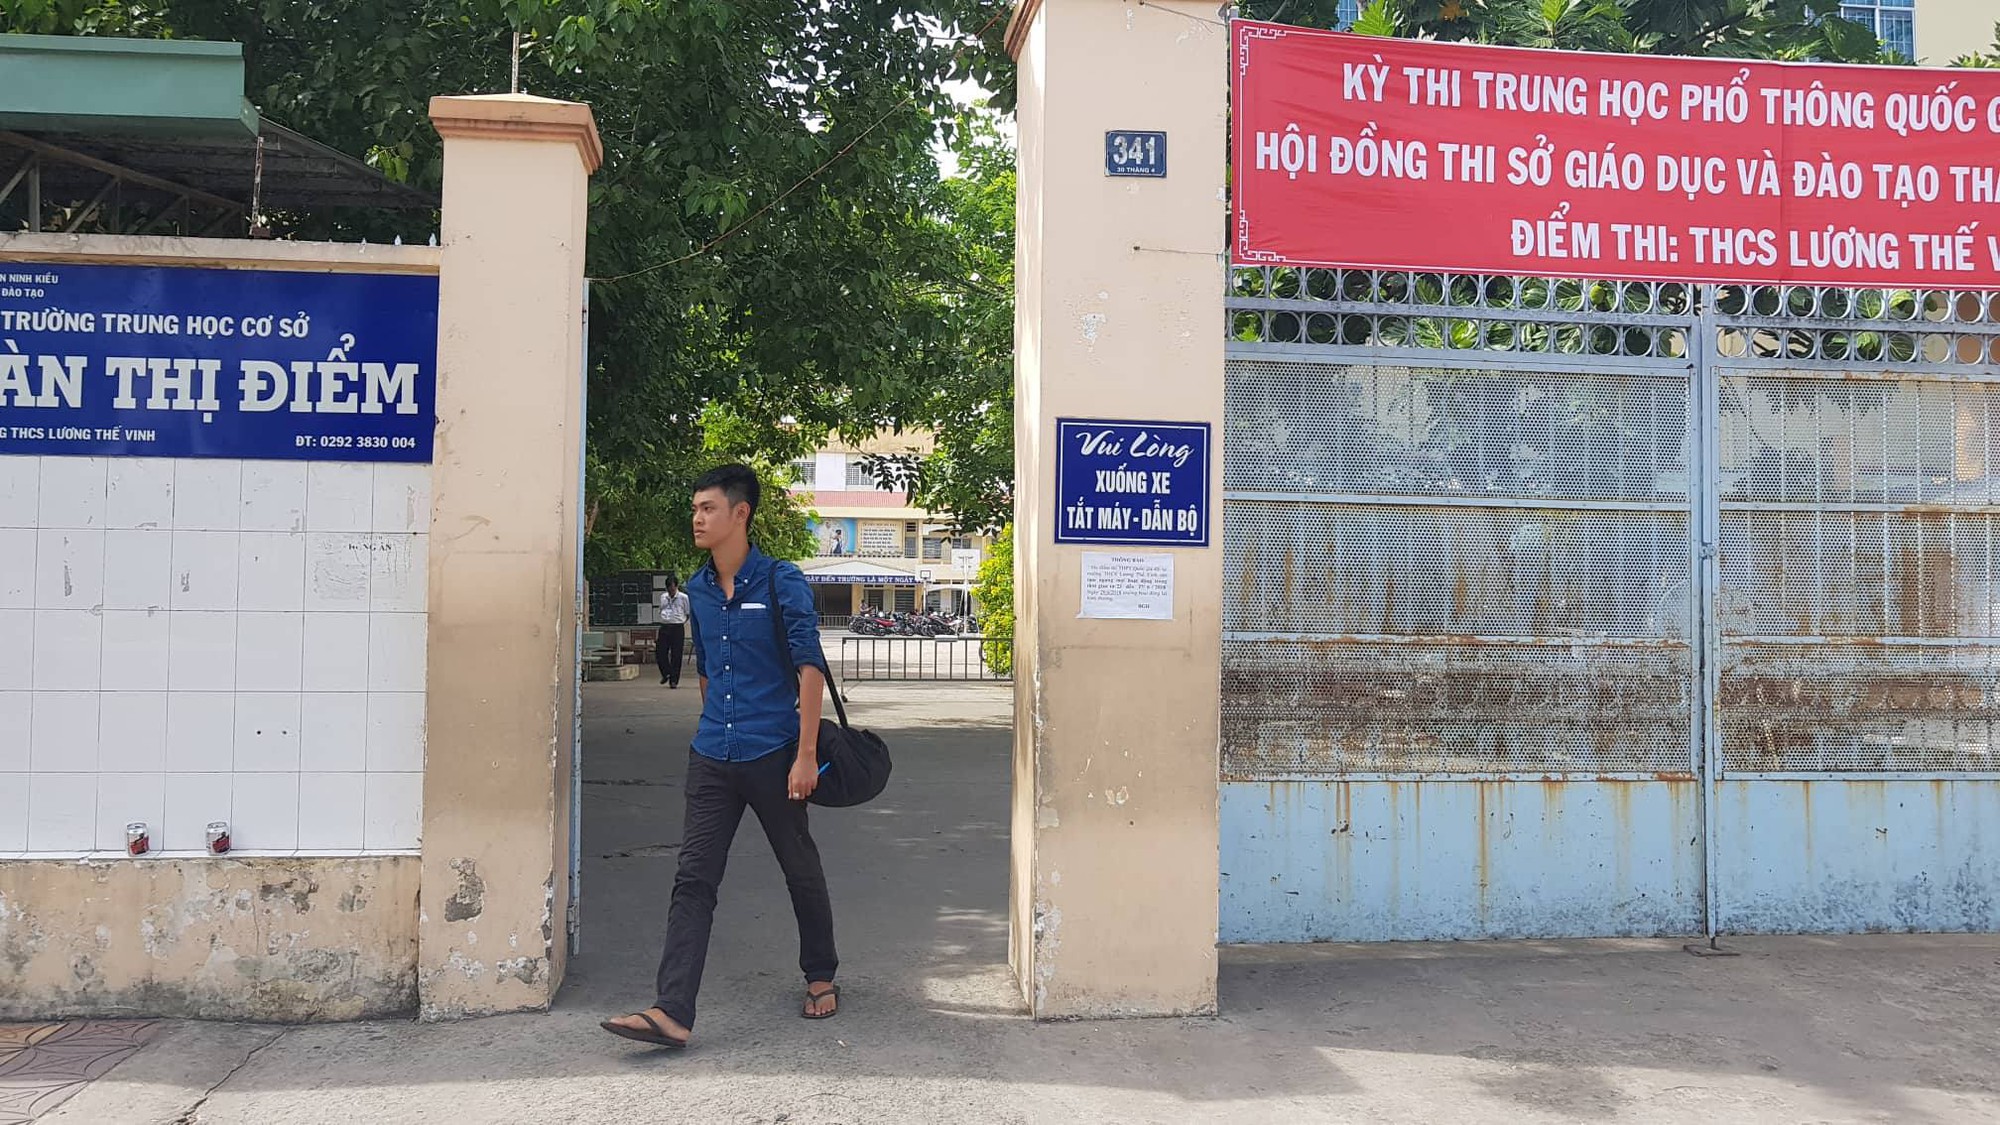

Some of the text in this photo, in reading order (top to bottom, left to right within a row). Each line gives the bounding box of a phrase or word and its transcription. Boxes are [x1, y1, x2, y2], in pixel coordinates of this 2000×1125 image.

[1344, 55, 1389, 101] KỲ
[1403, 67, 1460, 106] THI
[1473, 72, 1587, 115] TRUNG
[1600, 80, 1668, 125] HỌC
[1681, 68, 1749, 123] PHỔ
[1761, 81, 1874, 128] THÔNG
[1885, 82, 1975, 136] QUỐC
[1113, 136, 1155, 165] 341
[1257, 122, 2000, 207] HỘI ĐỒNG THI SỞ GIÁO DỤC VÀ ĐÀO TẠO TH
[1511, 202, 1599, 258] ĐIỂM
[1611, 224, 1678, 262] THI:
[1689, 227, 1777, 265] THCS
[1790, 225, 1899, 269] LƯƠNG
[1909, 222, 1978, 270] THẾ
[2, 286, 45, 299] ĐÀO TẠO
[9, 274, 32, 282] NINH
[1, 307, 310, 339] TRƯỜNG TRUNG HỌC CƠ SỞ
[106, 357, 221, 422] THỊ
[239, 334, 418, 414] ĐIỂM
[11, 428, 44, 438] THCS
[49, 427, 91, 439] LƯƠNG
[95, 426, 122, 440] THẾ
[125, 430, 155, 441] VINH
[296, 436, 415, 448] ĐT: 0292 3830 004
[1076, 431, 1193, 467] Vui Lòng
[1096, 463, 1170, 494] XUỐNG XE
[1067, 497, 1094, 529] TẮT
[1178, 505, 1197, 536] BỘ
